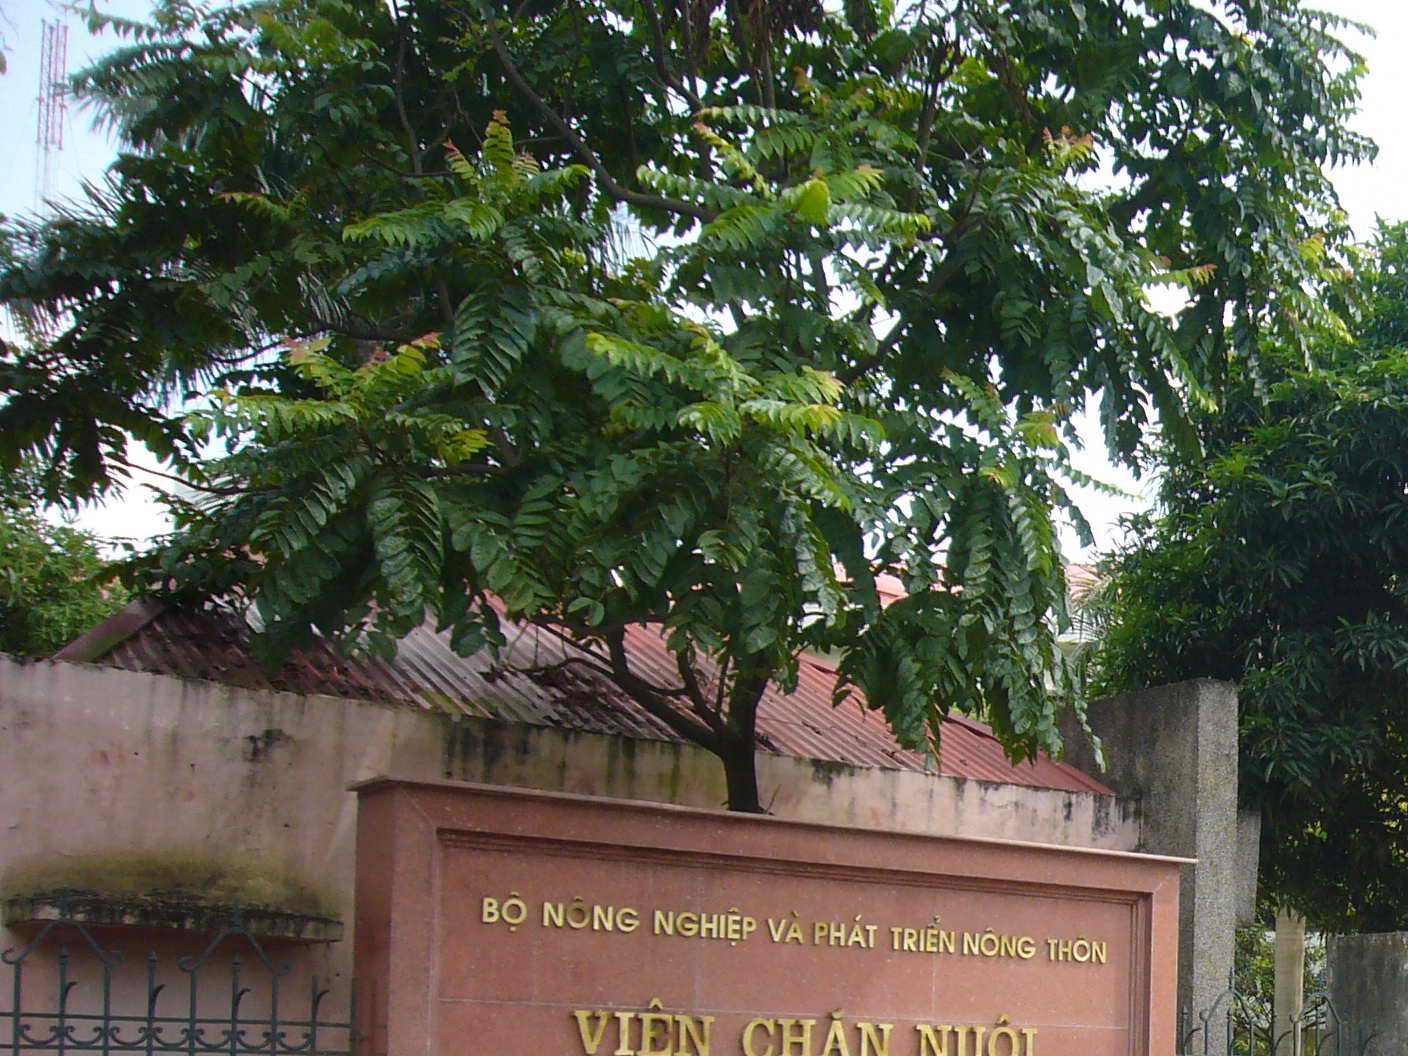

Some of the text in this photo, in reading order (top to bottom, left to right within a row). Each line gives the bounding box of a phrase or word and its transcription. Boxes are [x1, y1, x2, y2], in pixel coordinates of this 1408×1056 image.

[482, 891, 1107, 965] BỘ NÔNG NGHIỆP VÀ PHÁT TRIỂN NÔNG THÔN
